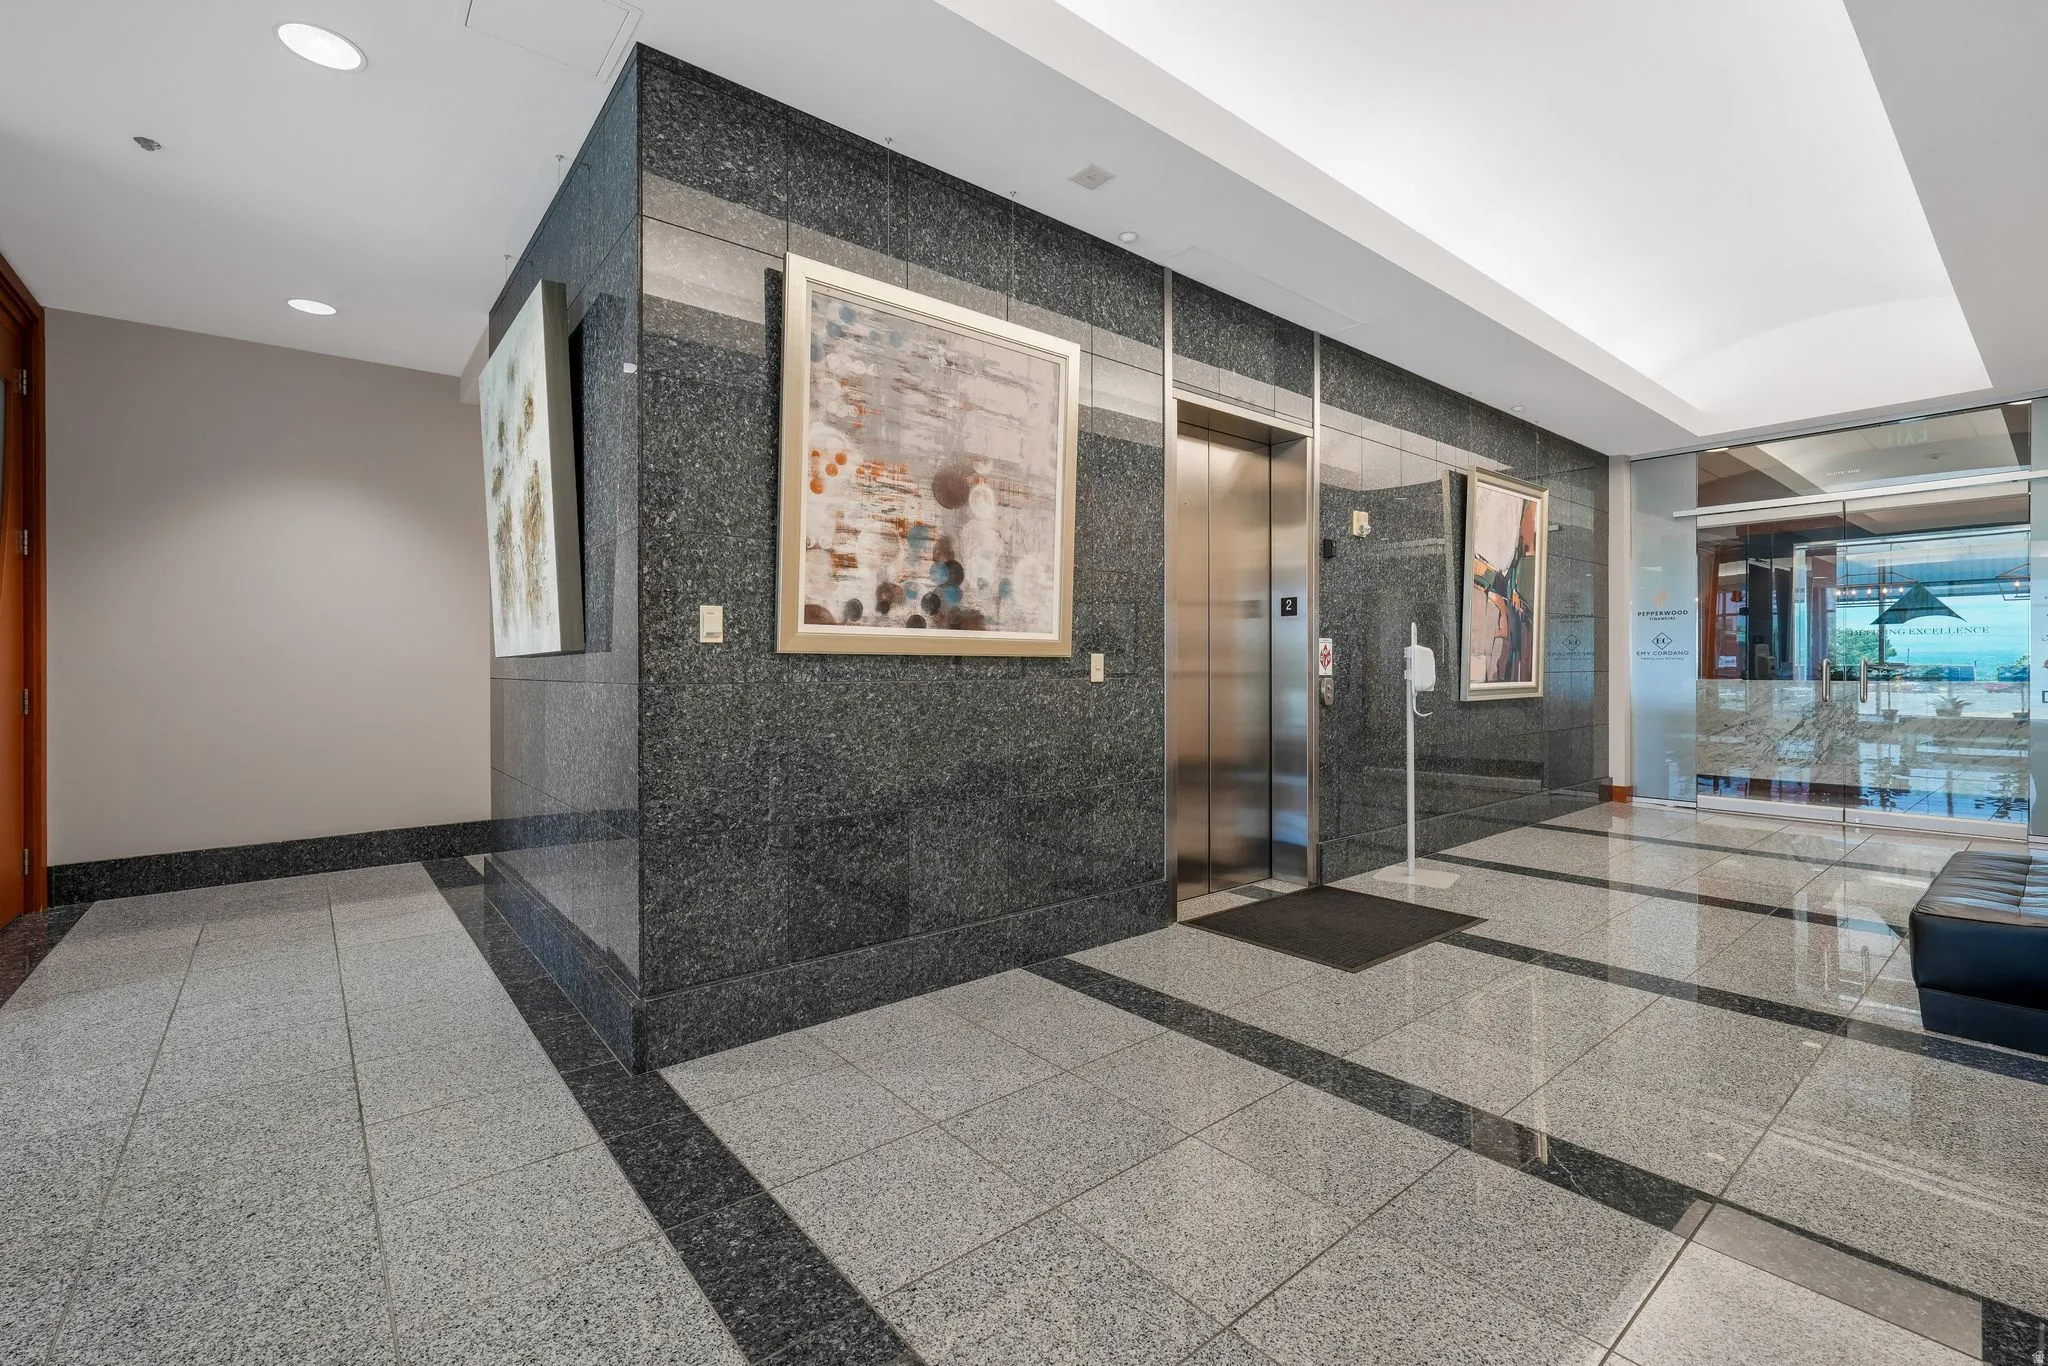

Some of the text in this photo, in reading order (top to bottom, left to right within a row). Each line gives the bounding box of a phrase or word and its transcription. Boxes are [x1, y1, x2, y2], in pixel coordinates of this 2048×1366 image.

[1286, 599, 1292, 610] 2
[1850, 625, 1990, 638] DEFIING EXCELLENCE
